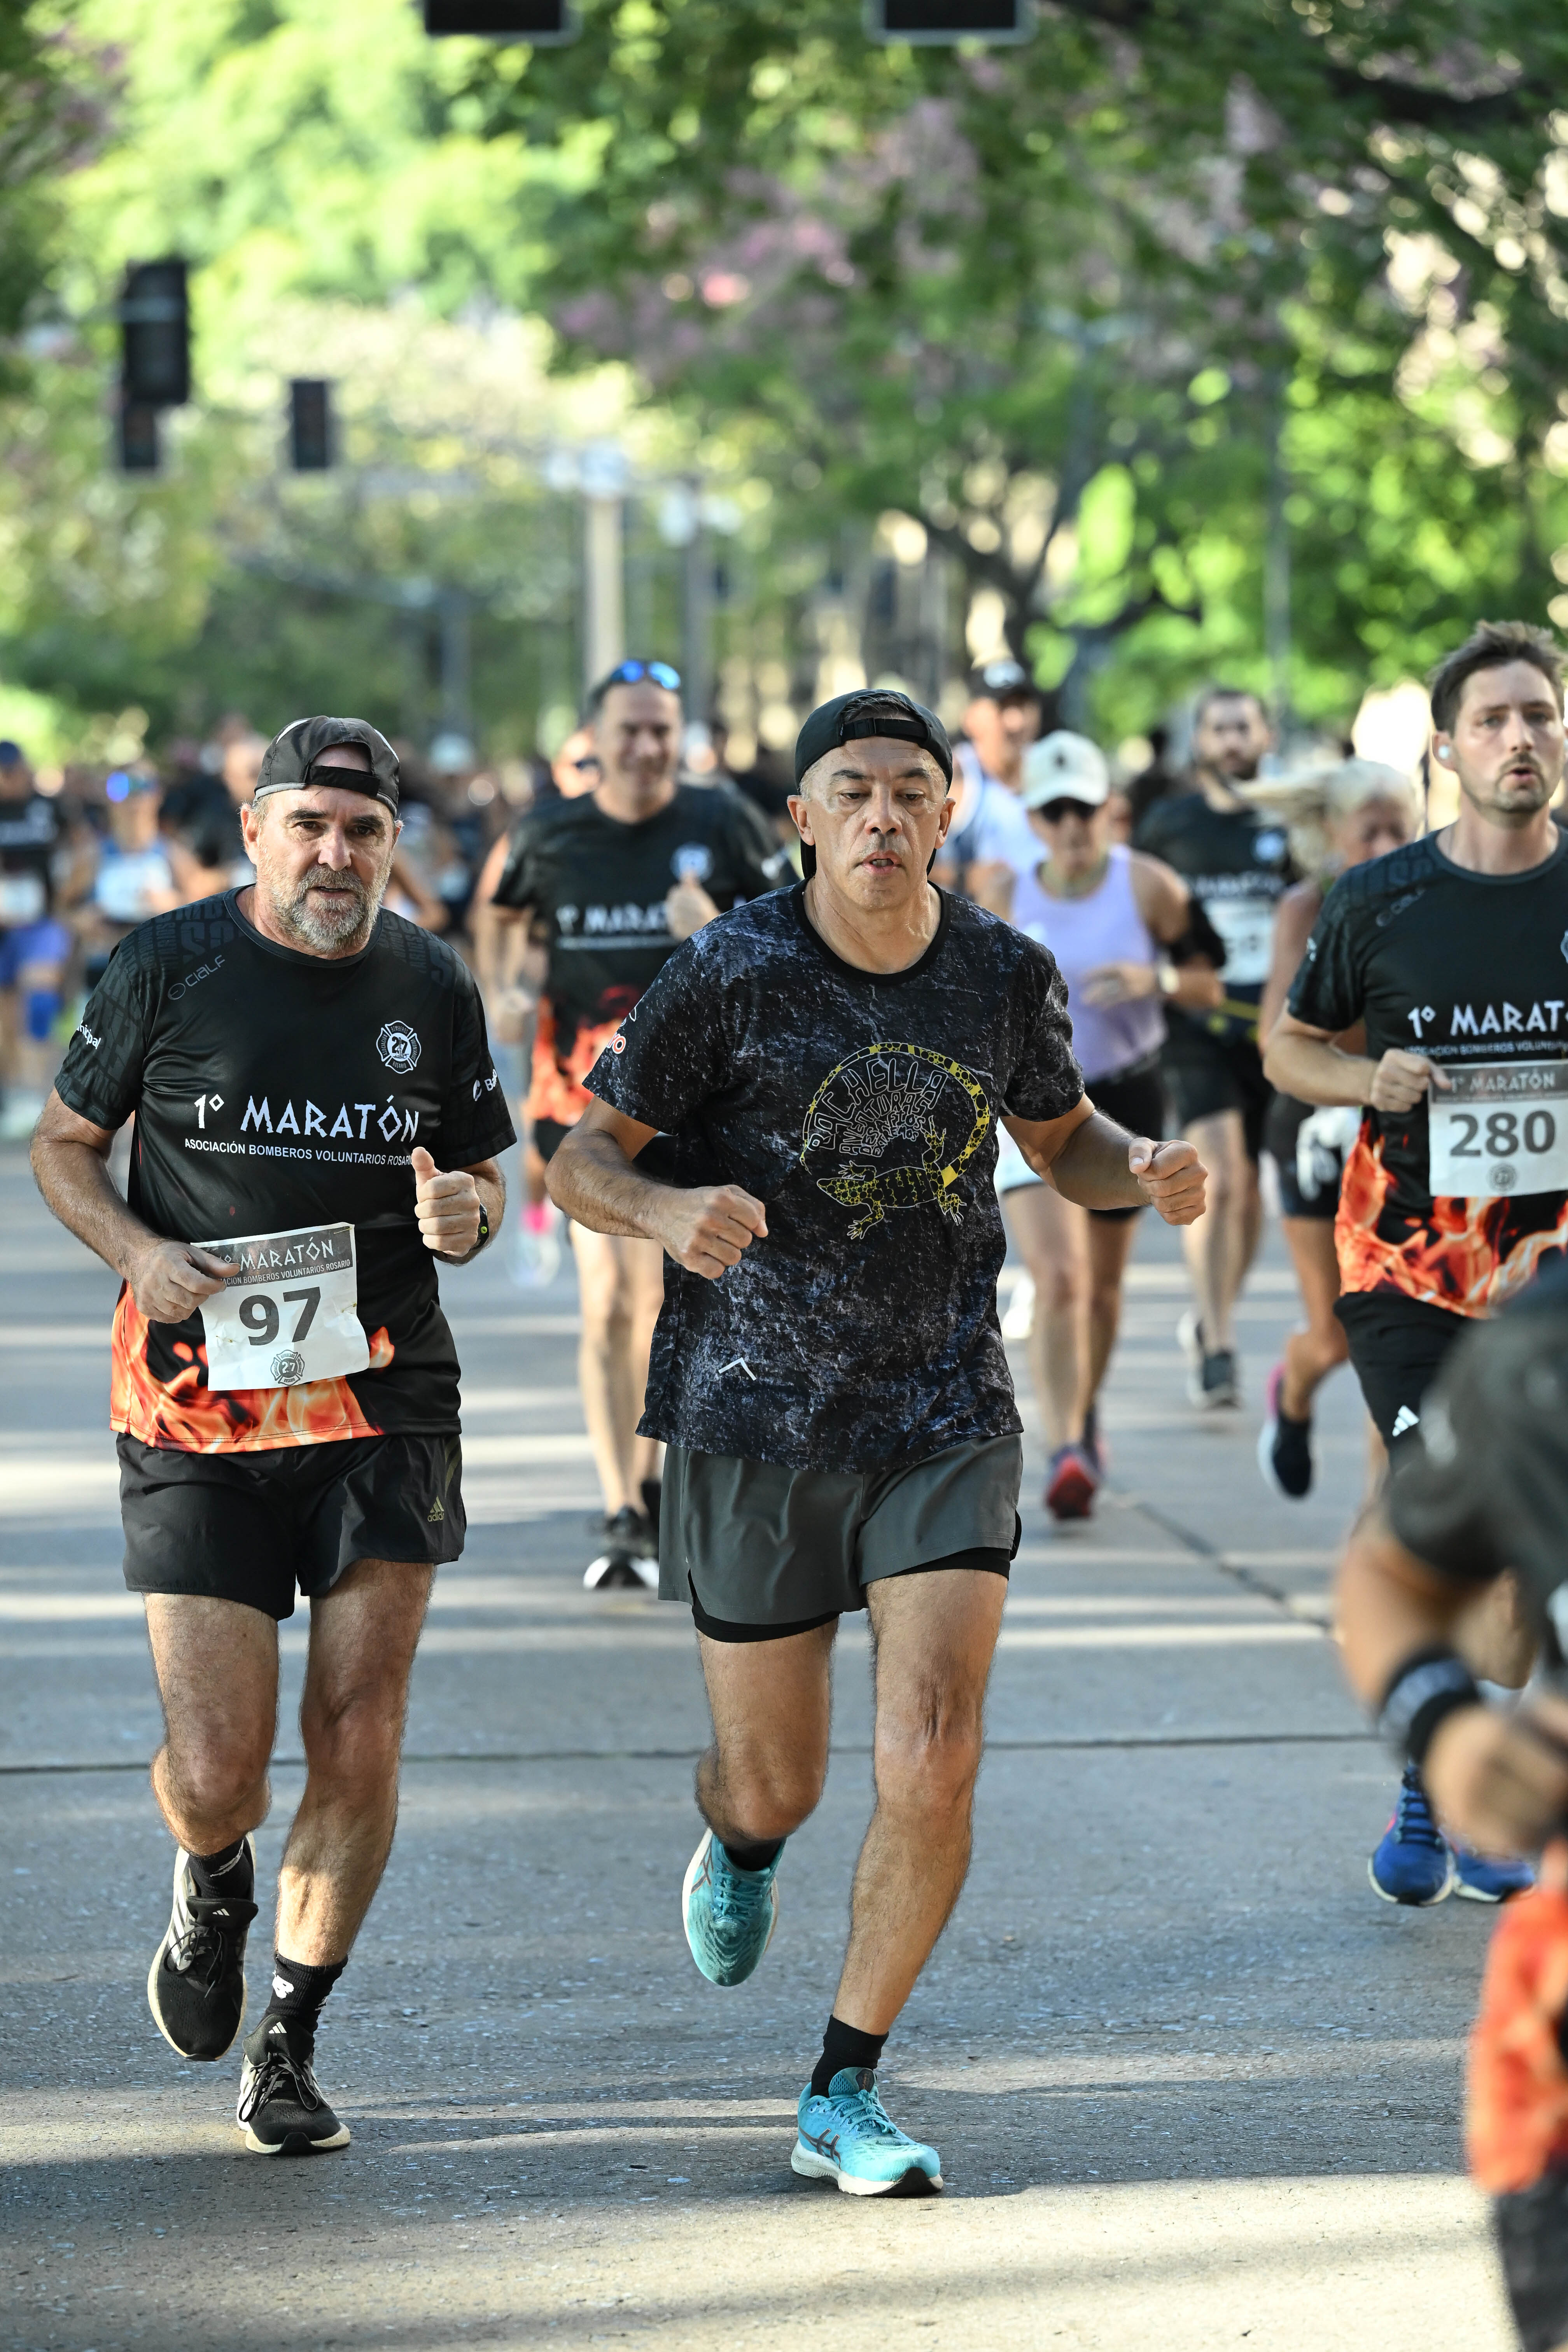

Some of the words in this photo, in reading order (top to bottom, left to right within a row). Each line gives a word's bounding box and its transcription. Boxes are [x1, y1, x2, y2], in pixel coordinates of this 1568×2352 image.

[391, 1026, 408, 1034] BOMBEROS
[1450, 1000, 1568, 1036] MARAT
[77, 1020, 101, 1049] nicipal
[392, 1036, 408, 1054] 27
[240, 1094, 419, 1143] MARATÓN
[1450, 1111, 1555, 1157] 280
[185, 1138, 245, 1154] ASOCIACIÓN
[249, 1144, 312, 1159] BOMBEROS
[315, 1150, 386, 1165] VOLUNTARIOS
[240, 1236, 334, 1271] MARATÓN
[243, 1272, 280, 1284] BOMBEROS
[281, 1265, 325, 1279] VOLUNTARIOS
[326, 1259, 351, 1271] ROSARIO
[239, 1286, 321, 1346] 97
[282, 1361, 296, 1374] 27
[427, 1511, 444, 1522] adid
